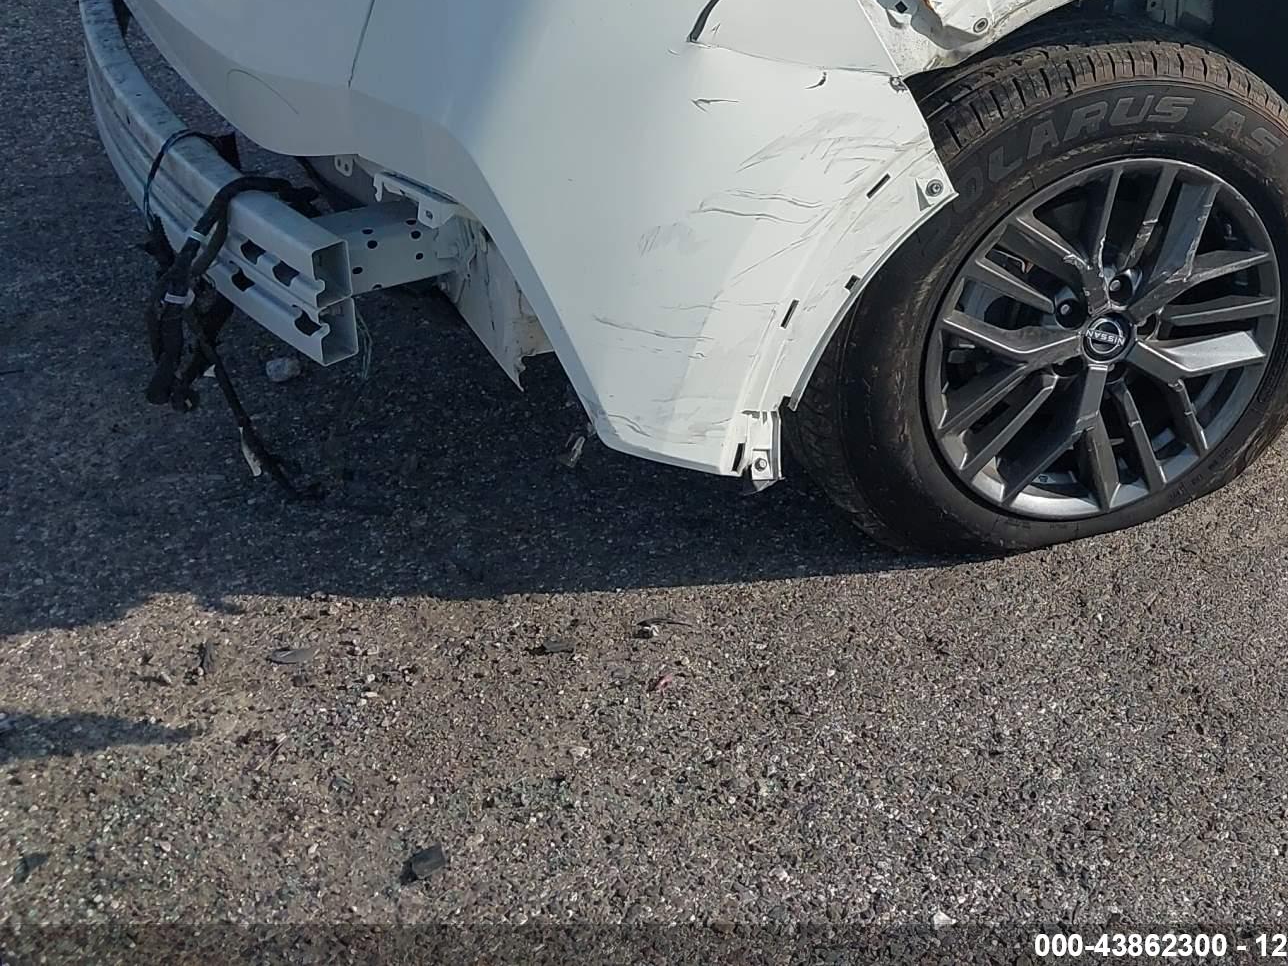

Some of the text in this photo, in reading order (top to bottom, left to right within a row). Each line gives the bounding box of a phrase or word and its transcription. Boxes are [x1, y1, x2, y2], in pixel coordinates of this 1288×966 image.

[952, 95, 1284, 214] OLARUS AS
[1085, 329, 1126, 347] NISSAN
